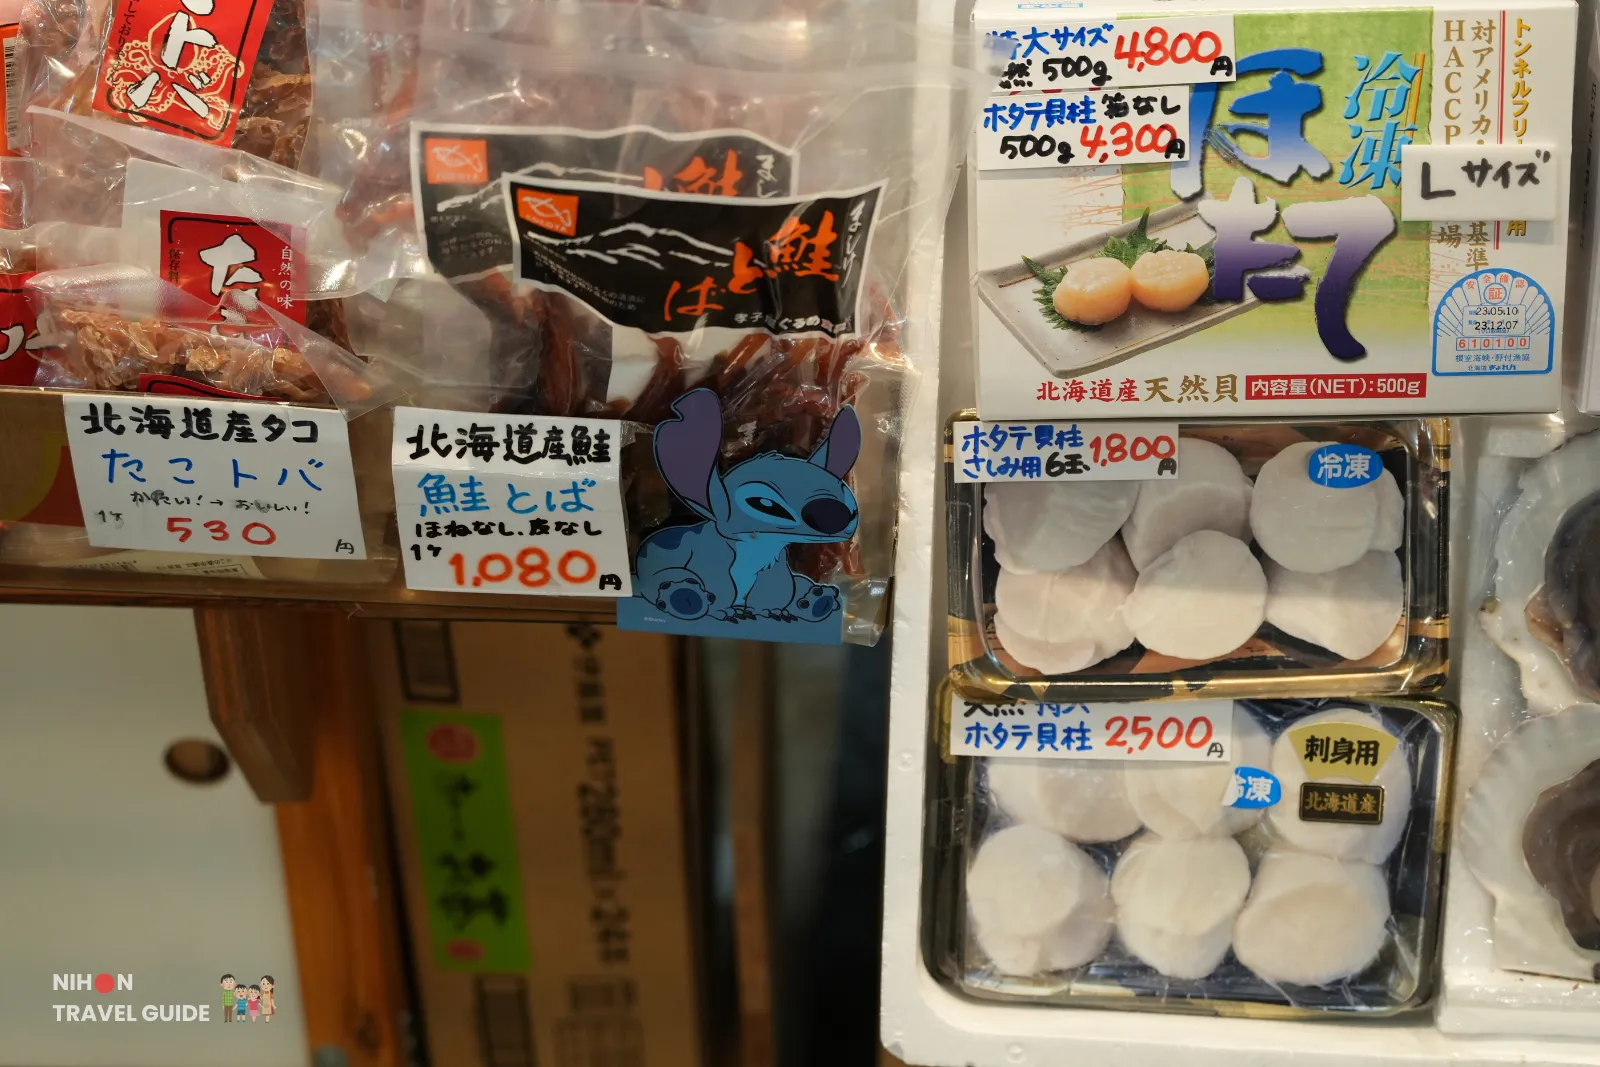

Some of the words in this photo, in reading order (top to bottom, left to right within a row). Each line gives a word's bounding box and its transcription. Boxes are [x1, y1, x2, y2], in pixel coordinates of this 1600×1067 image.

[1042, 55, 1113, 87] 500g
[983, 95, 1097, 132] ホタテ貝柱
[1339, 51, 1422, 190] 冷凍
[999, 134, 1076, 164] 500g
[1420, 161, 1457, 201] L
[1461, 148, 1552, 188] サイズ
[277, 245, 294, 310] 自然の味
[1474, 320, 1519, 331] 23.12.07
[1475, 306, 1519, 317] 23.05.10
[1458, 338, 1528, 350] 610100
[80, 401, 320, 444] 北海道産タコ
[406, 422, 612, 467] 北海道産鮭
[961, 423, 1085, 455] ホタテ貝柱
[101, 448, 325, 491] たこトバ
[1317, 451, 1372, 480] 冷凍
[417, 472, 597, 517] 鮭とば
[166, 516, 277, 546] 530
[964, 720, 1094, 752] ホタテ貝柱
[1304, 735, 1381, 768] 刺身用
[1305, 791, 1378, 814] 北海道産
